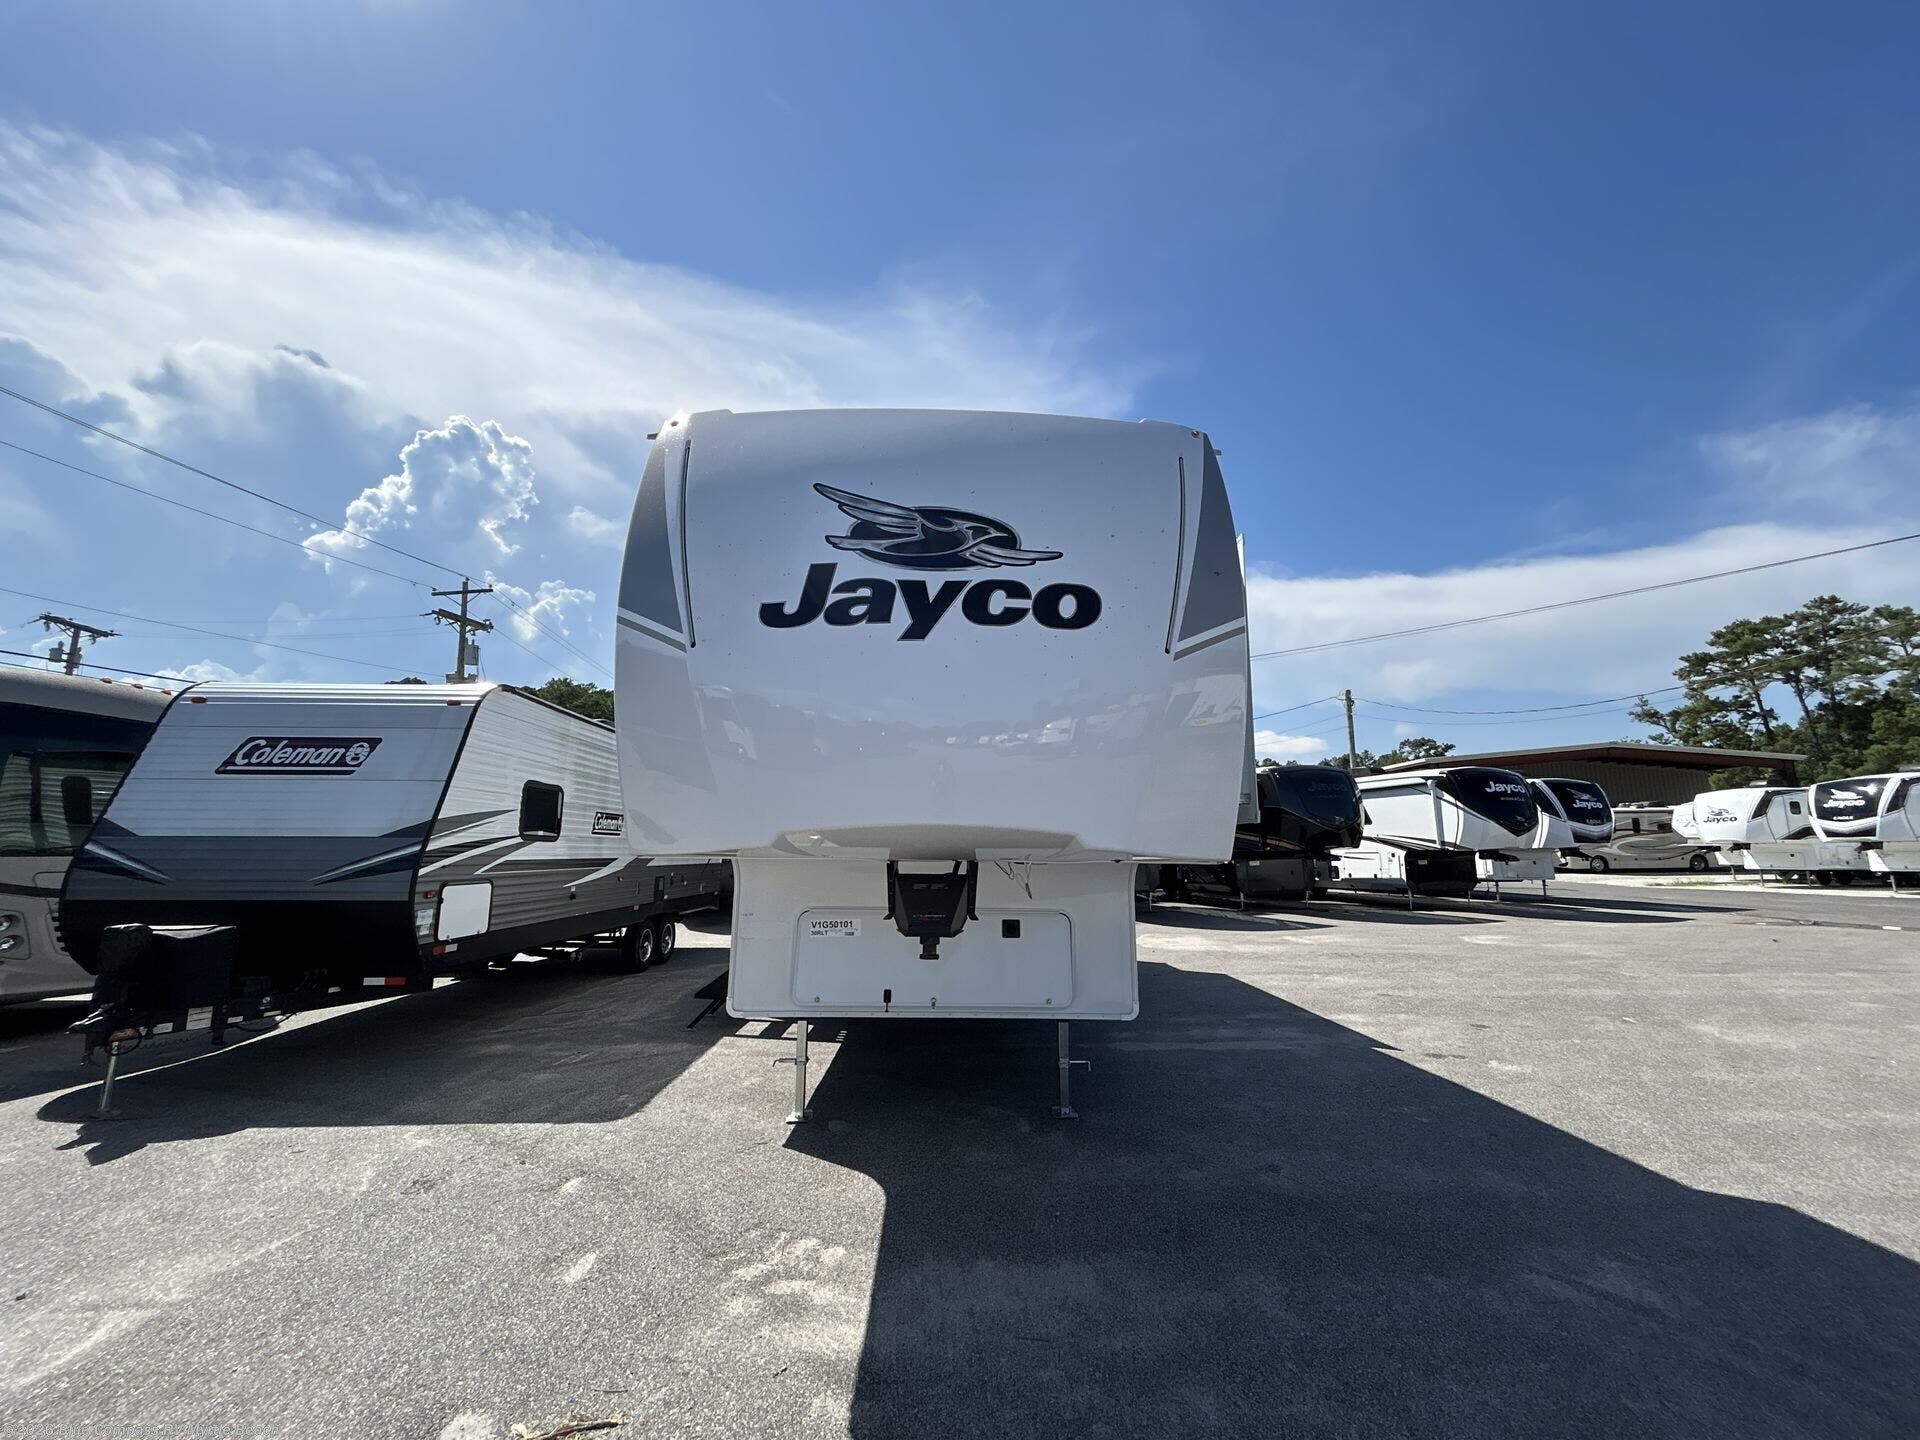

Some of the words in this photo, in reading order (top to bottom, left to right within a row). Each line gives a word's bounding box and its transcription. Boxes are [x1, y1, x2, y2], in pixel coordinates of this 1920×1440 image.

[758, 561, 1103, 642] Jayco
[234, 739, 346, 766] Coleman
[1484, 781, 1526, 793] Jayco
[1572, 799, 1603, 809] Jayco
[1823, 799, 1866, 808] Jayco
[594, 813, 619, 829] Coleman
[810, 920, 853, 929] V1G50101
